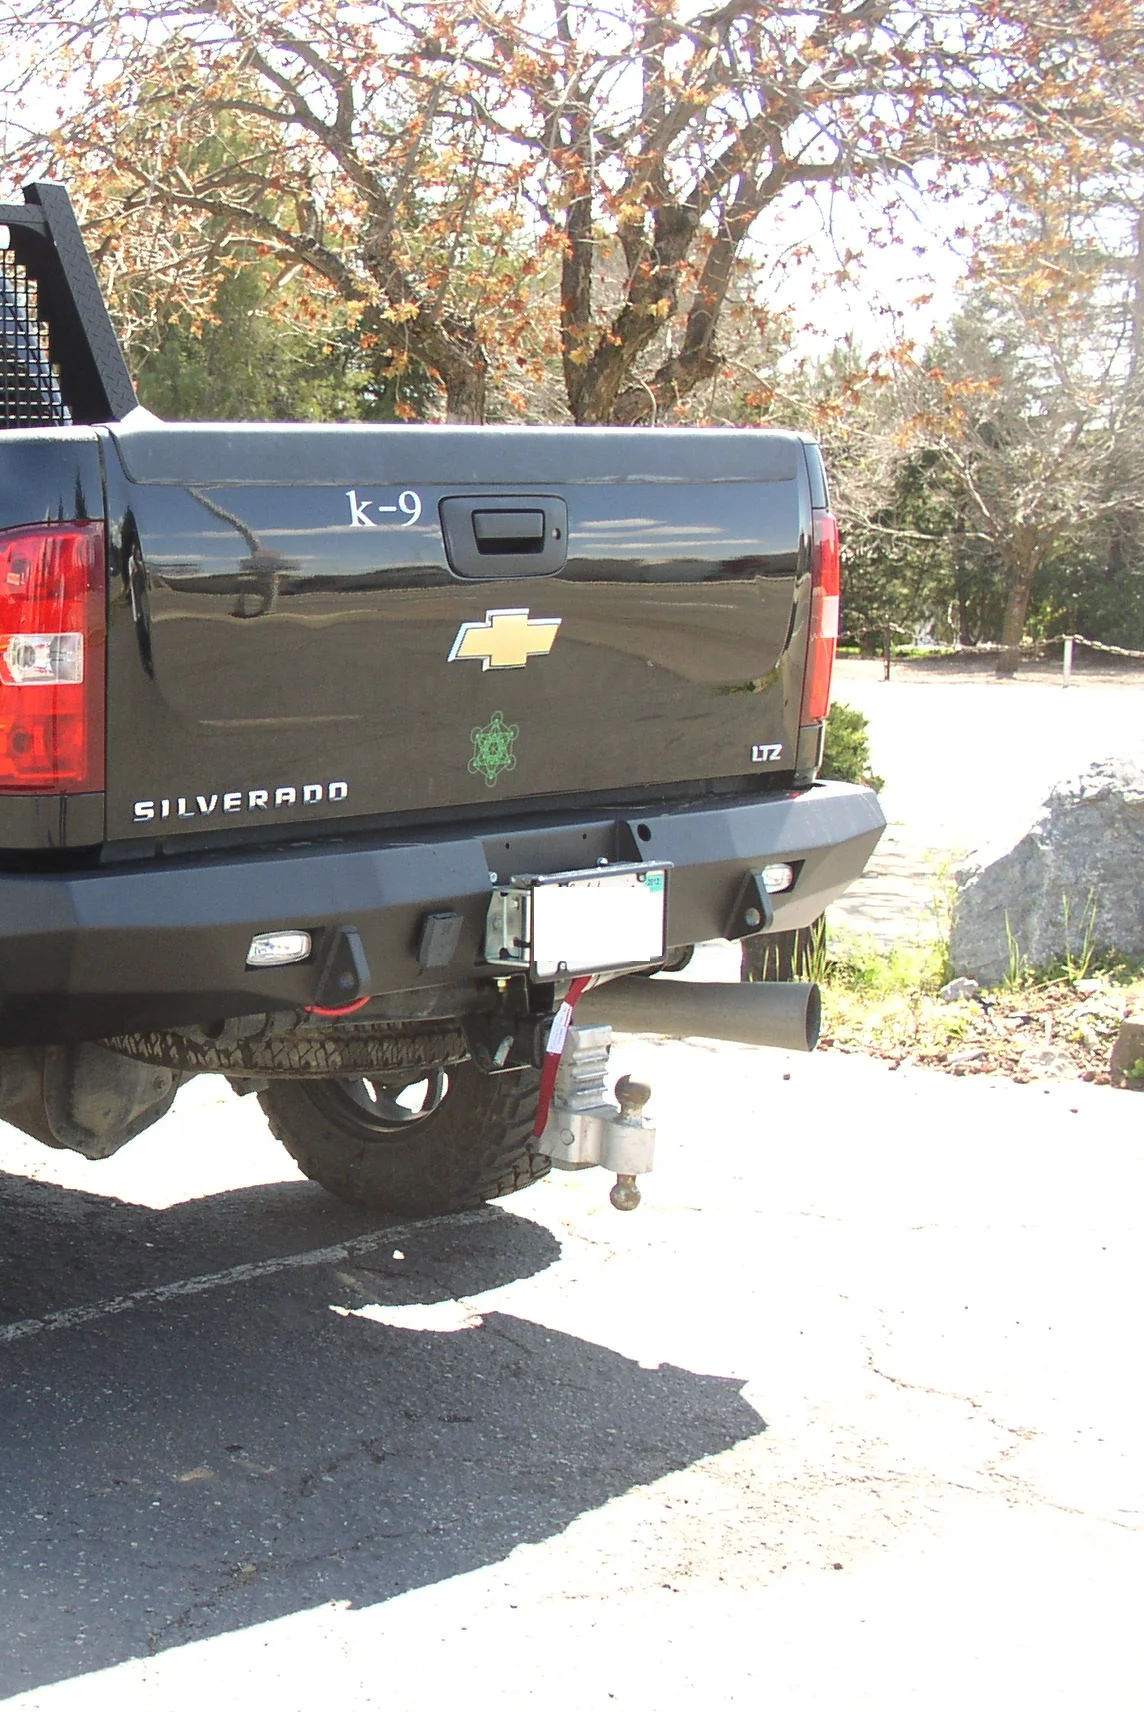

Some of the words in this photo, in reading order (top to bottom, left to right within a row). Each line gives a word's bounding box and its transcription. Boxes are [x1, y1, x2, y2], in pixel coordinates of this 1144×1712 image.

[345, 490, 422, 528] k-9
[752, 743, 783, 762] LTZ
[133, 781, 349, 823] SILVERADO
